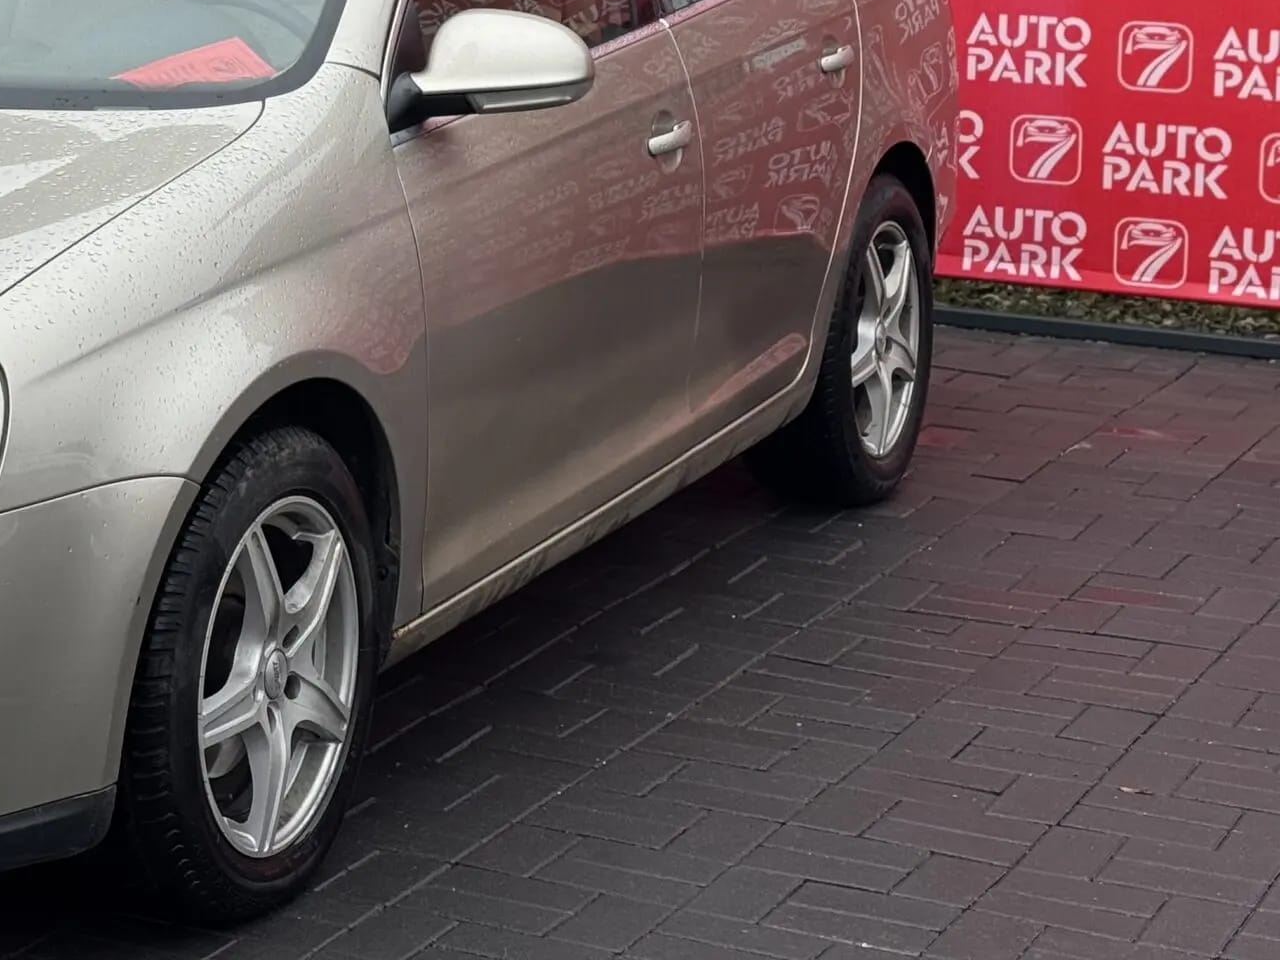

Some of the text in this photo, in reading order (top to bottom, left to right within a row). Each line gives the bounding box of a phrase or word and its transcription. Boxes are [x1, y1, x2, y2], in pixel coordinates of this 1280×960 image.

[967, 14, 1091, 51] AUTO
[967, 47, 1086, 87] PARK
[1103, 122, 1232, 162] AUTO
[1103, 156, 1227, 199] PARK
[963, 206, 1086, 245] AUTO
[962, 239, 1082, 281] PARK
